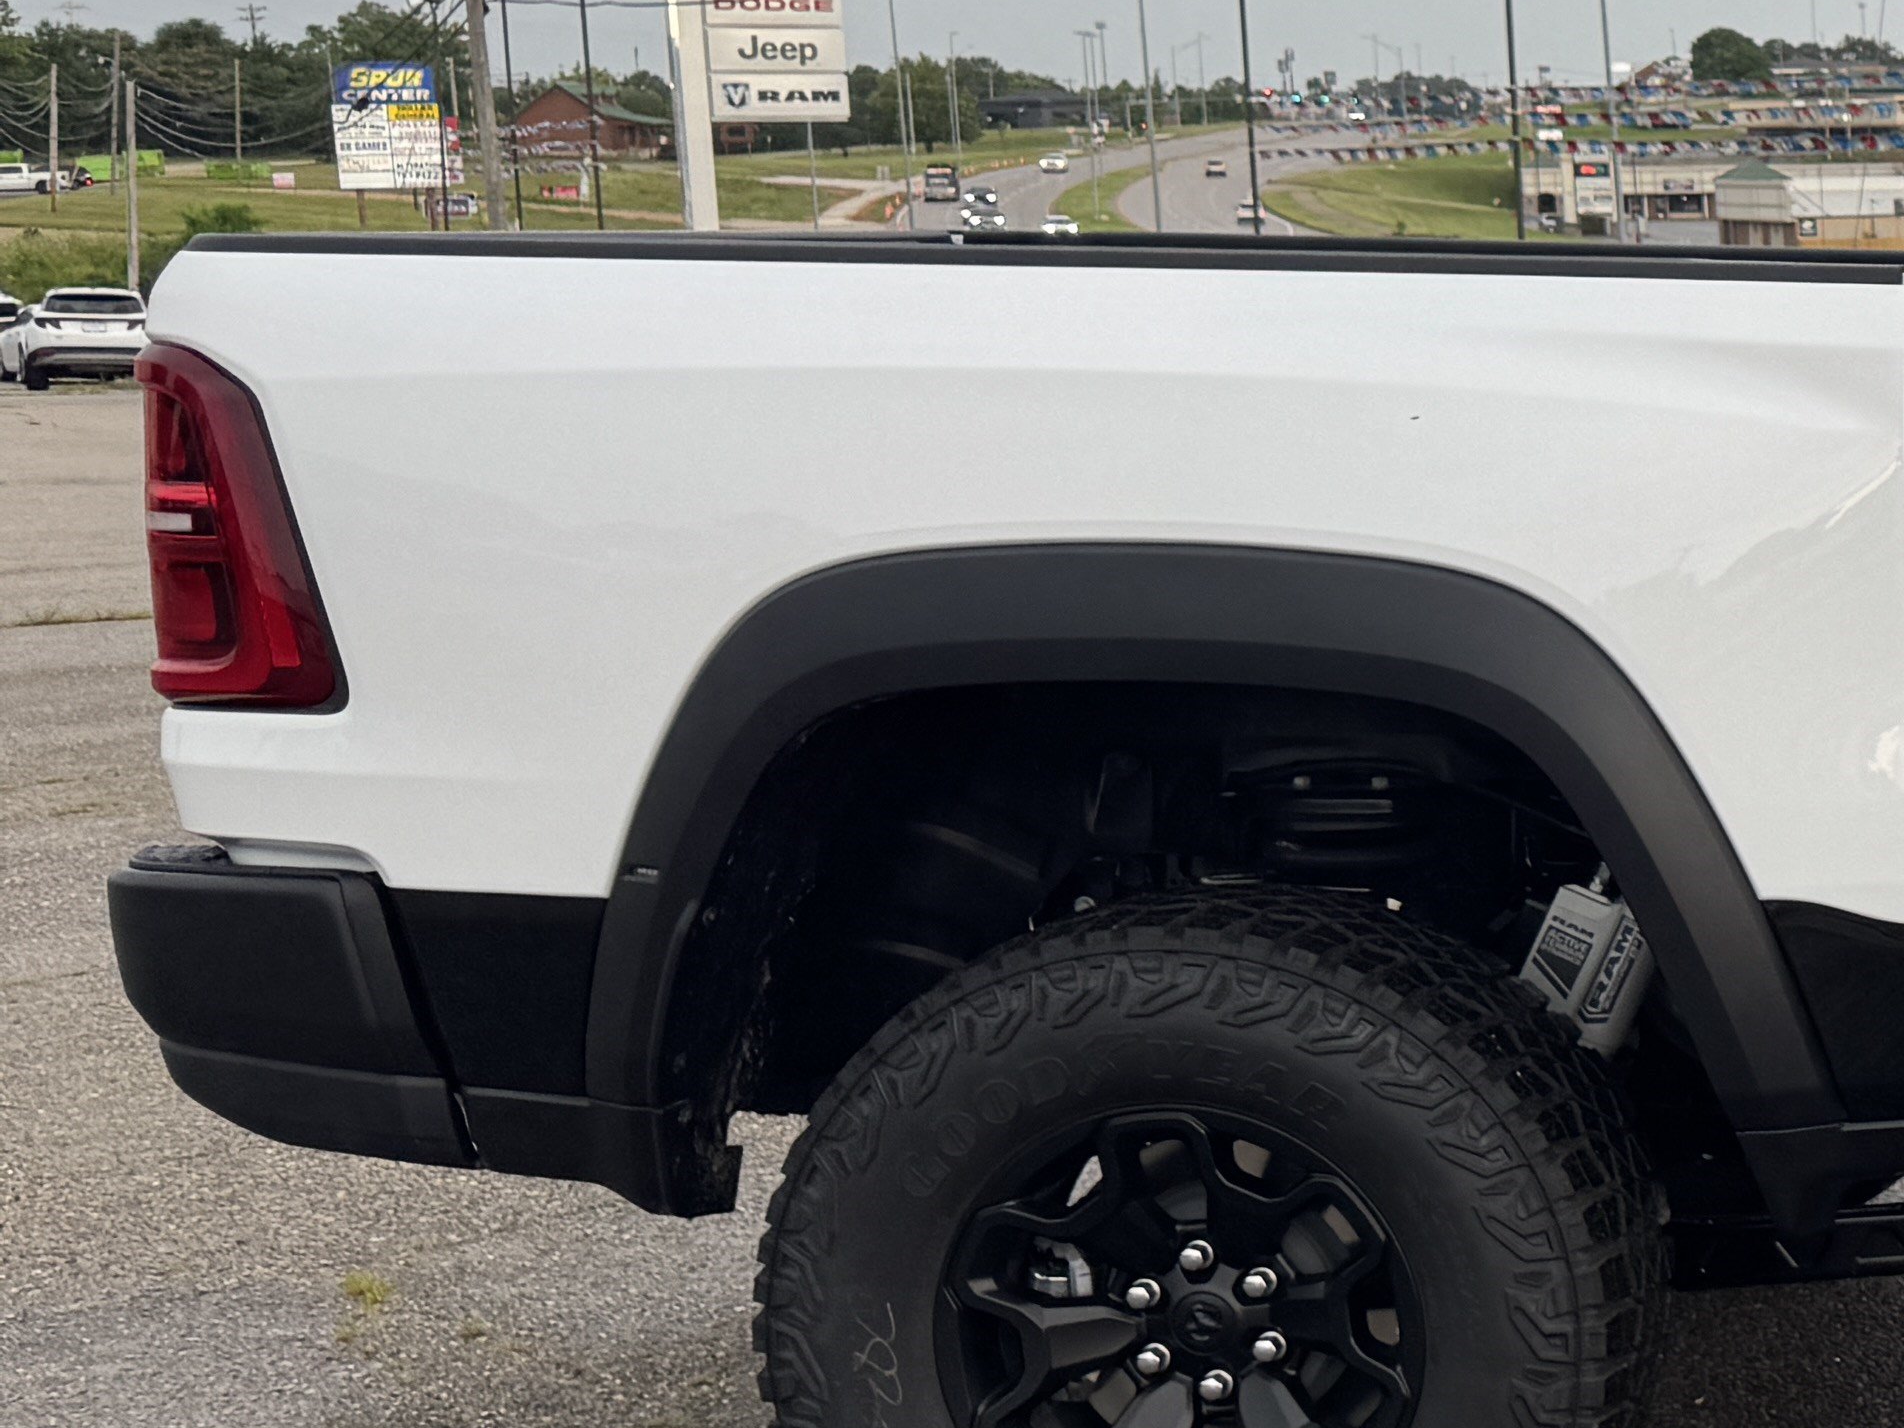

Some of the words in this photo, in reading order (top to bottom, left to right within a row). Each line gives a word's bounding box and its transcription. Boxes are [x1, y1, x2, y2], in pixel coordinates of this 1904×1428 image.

[737, 34, 818, 66] Jeep
[757, 90, 840, 104] RAM
[1587, 923, 1636, 1010] RAM
[896, 1031, 1348, 1199] GOODYEAR
